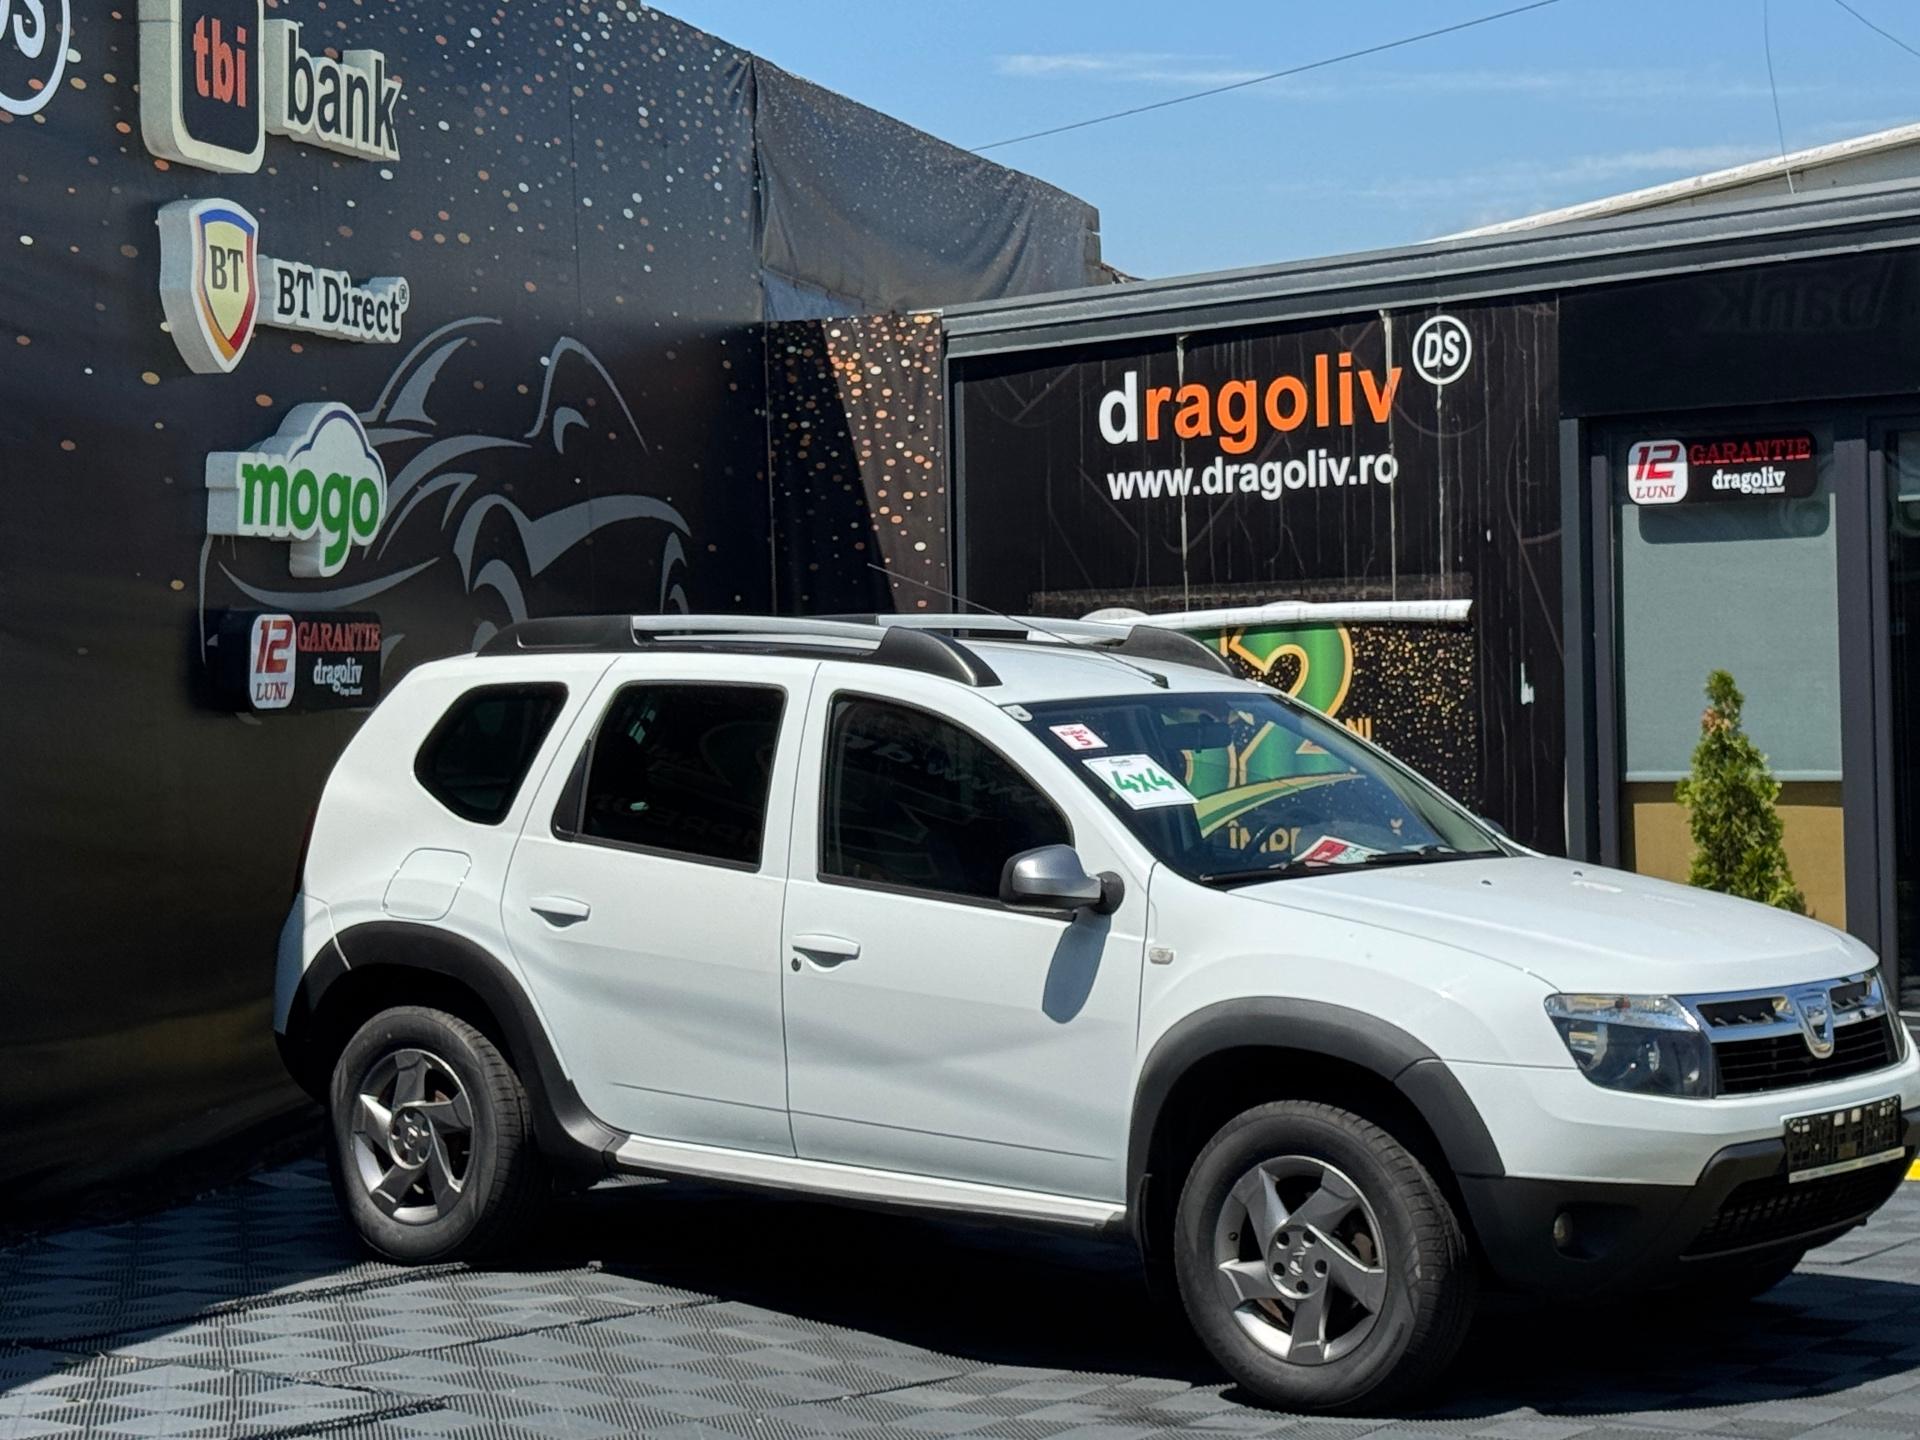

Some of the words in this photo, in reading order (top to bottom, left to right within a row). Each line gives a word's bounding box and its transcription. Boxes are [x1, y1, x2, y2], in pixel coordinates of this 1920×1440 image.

[193, 15, 248, 108] tbi
[287, 28, 400, 155] bank
[209, 245, 244, 293] BT
[277, 266, 314, 319] BT
[1423, 331, 1461, 368] DS
[1099, 352, 1402, 454] dragoliv
[1635, 445, 1680, 480] 12
[1689, 438, 1811, 464] GARANTIE
[1106, 449, 1399, 500] www.dragoliv.ro
[1635, 485, 1676, 499] LUNI
[1711, 466, 1786, 493] dragoliv
[242, 463, 379, 568] mogo
[255, 620, 293, 673] 12
[298, 622, 381, 652] GARANTIE
[255, 681, 287, 701] LUNI
[313, 657, 363, 692] dragoliv
[1073, 734, 1093, 746] 5
